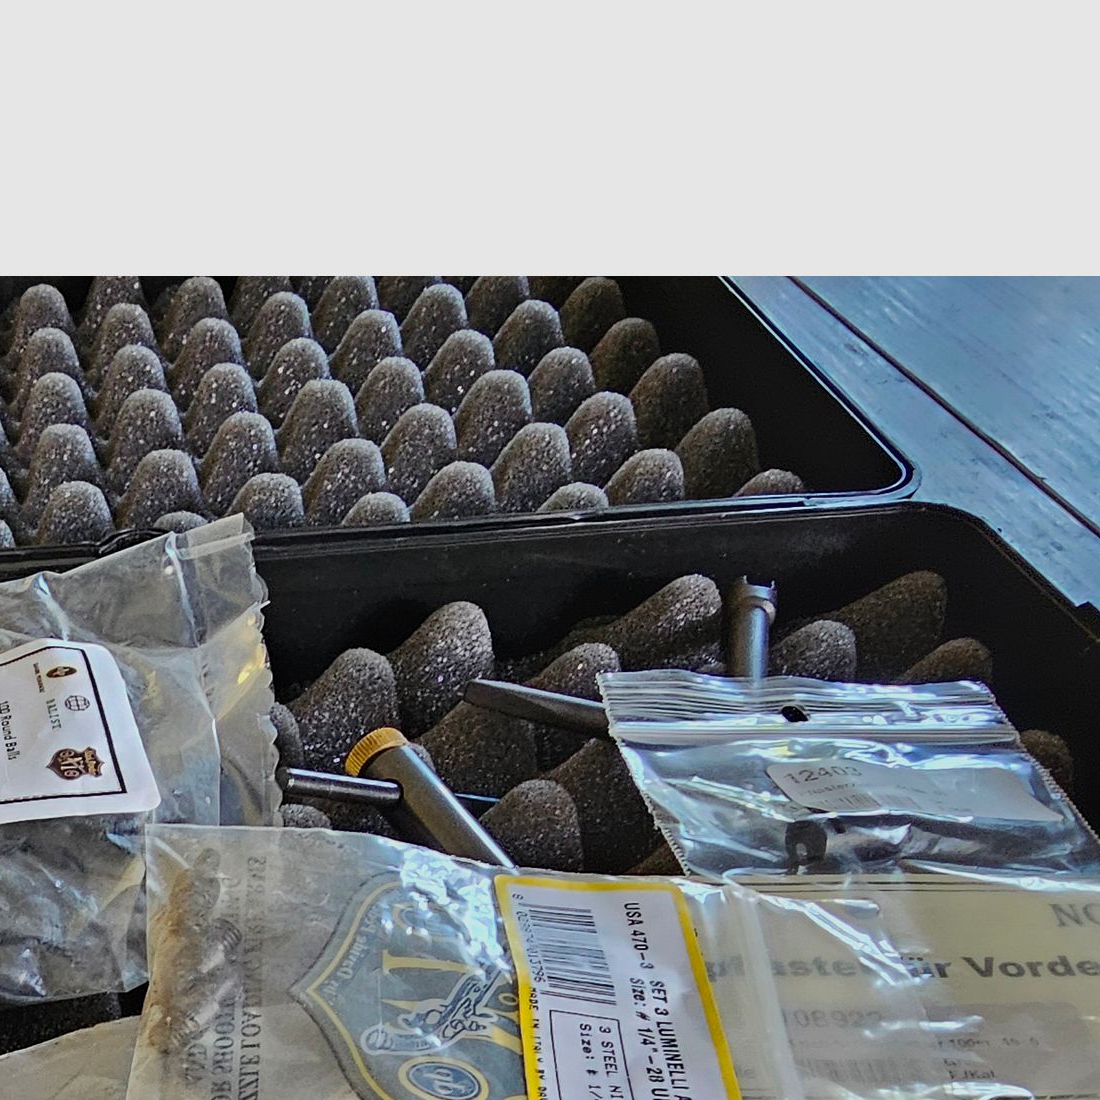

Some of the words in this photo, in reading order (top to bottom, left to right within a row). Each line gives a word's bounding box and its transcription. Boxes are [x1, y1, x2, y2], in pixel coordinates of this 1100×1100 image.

[0, 715, 16, 740] Round
[5, 741, 20, 760] Balls
[623, 902, 642, 926] USA
[630, 929, 654, 970] 470-3
[527, 986, 538, 1011] MADE
[629, 978, 650, 1007] Size:
[649, 980, 668, 1002] SET
[530, 1018, 540, 1029] IN
[654, 1008, 670, 1016] 3
[579, 1023, 594, 1061] Size:
[599, 1026, 612, 1034] 3
[600, 1041, 617, 1078] STEEL
[657, 1021, 688, 1091] LUMINELLI
[535, 1068, 546, 1080] BY
